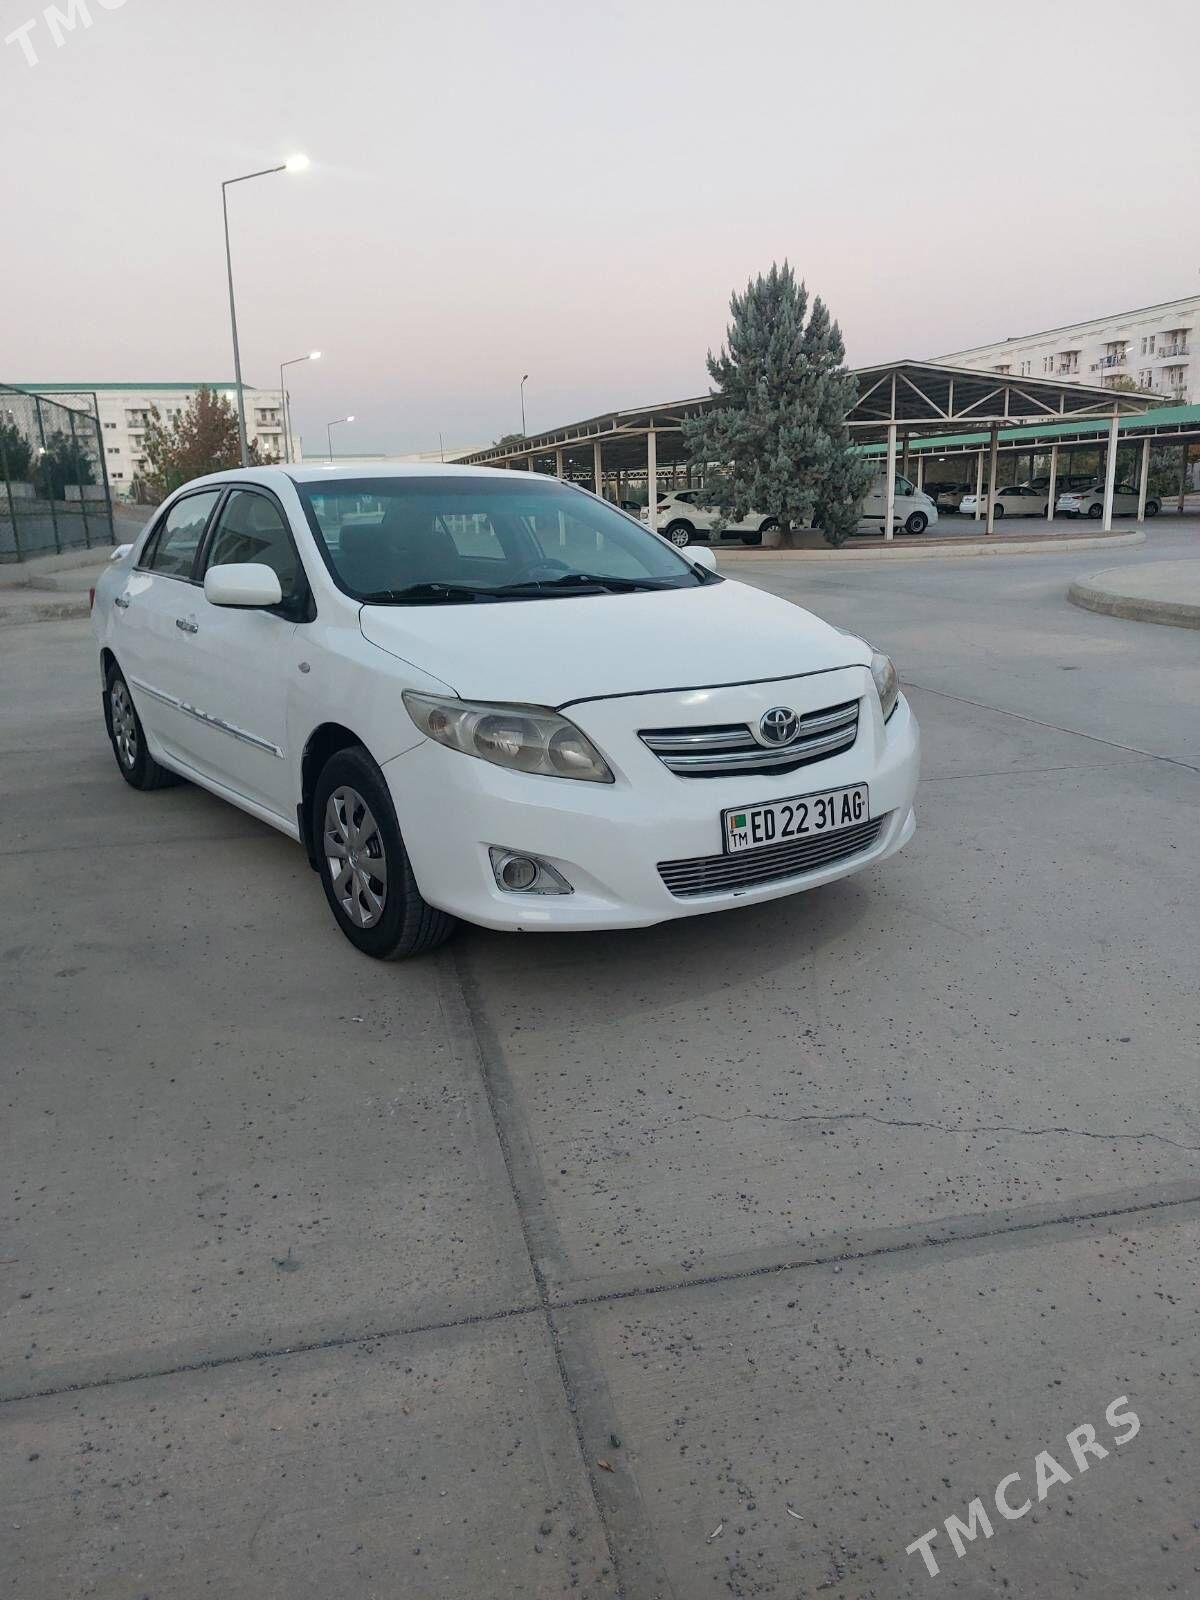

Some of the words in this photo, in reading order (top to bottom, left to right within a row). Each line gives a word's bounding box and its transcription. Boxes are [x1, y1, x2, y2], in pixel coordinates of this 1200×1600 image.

[751, 809, 776, 843] ED
[780, 803, 809, 837] 22
[814, 796, 835, 829] 31
[841, 791, 862, 824] AG
[731, 832, 747, 847] TM
